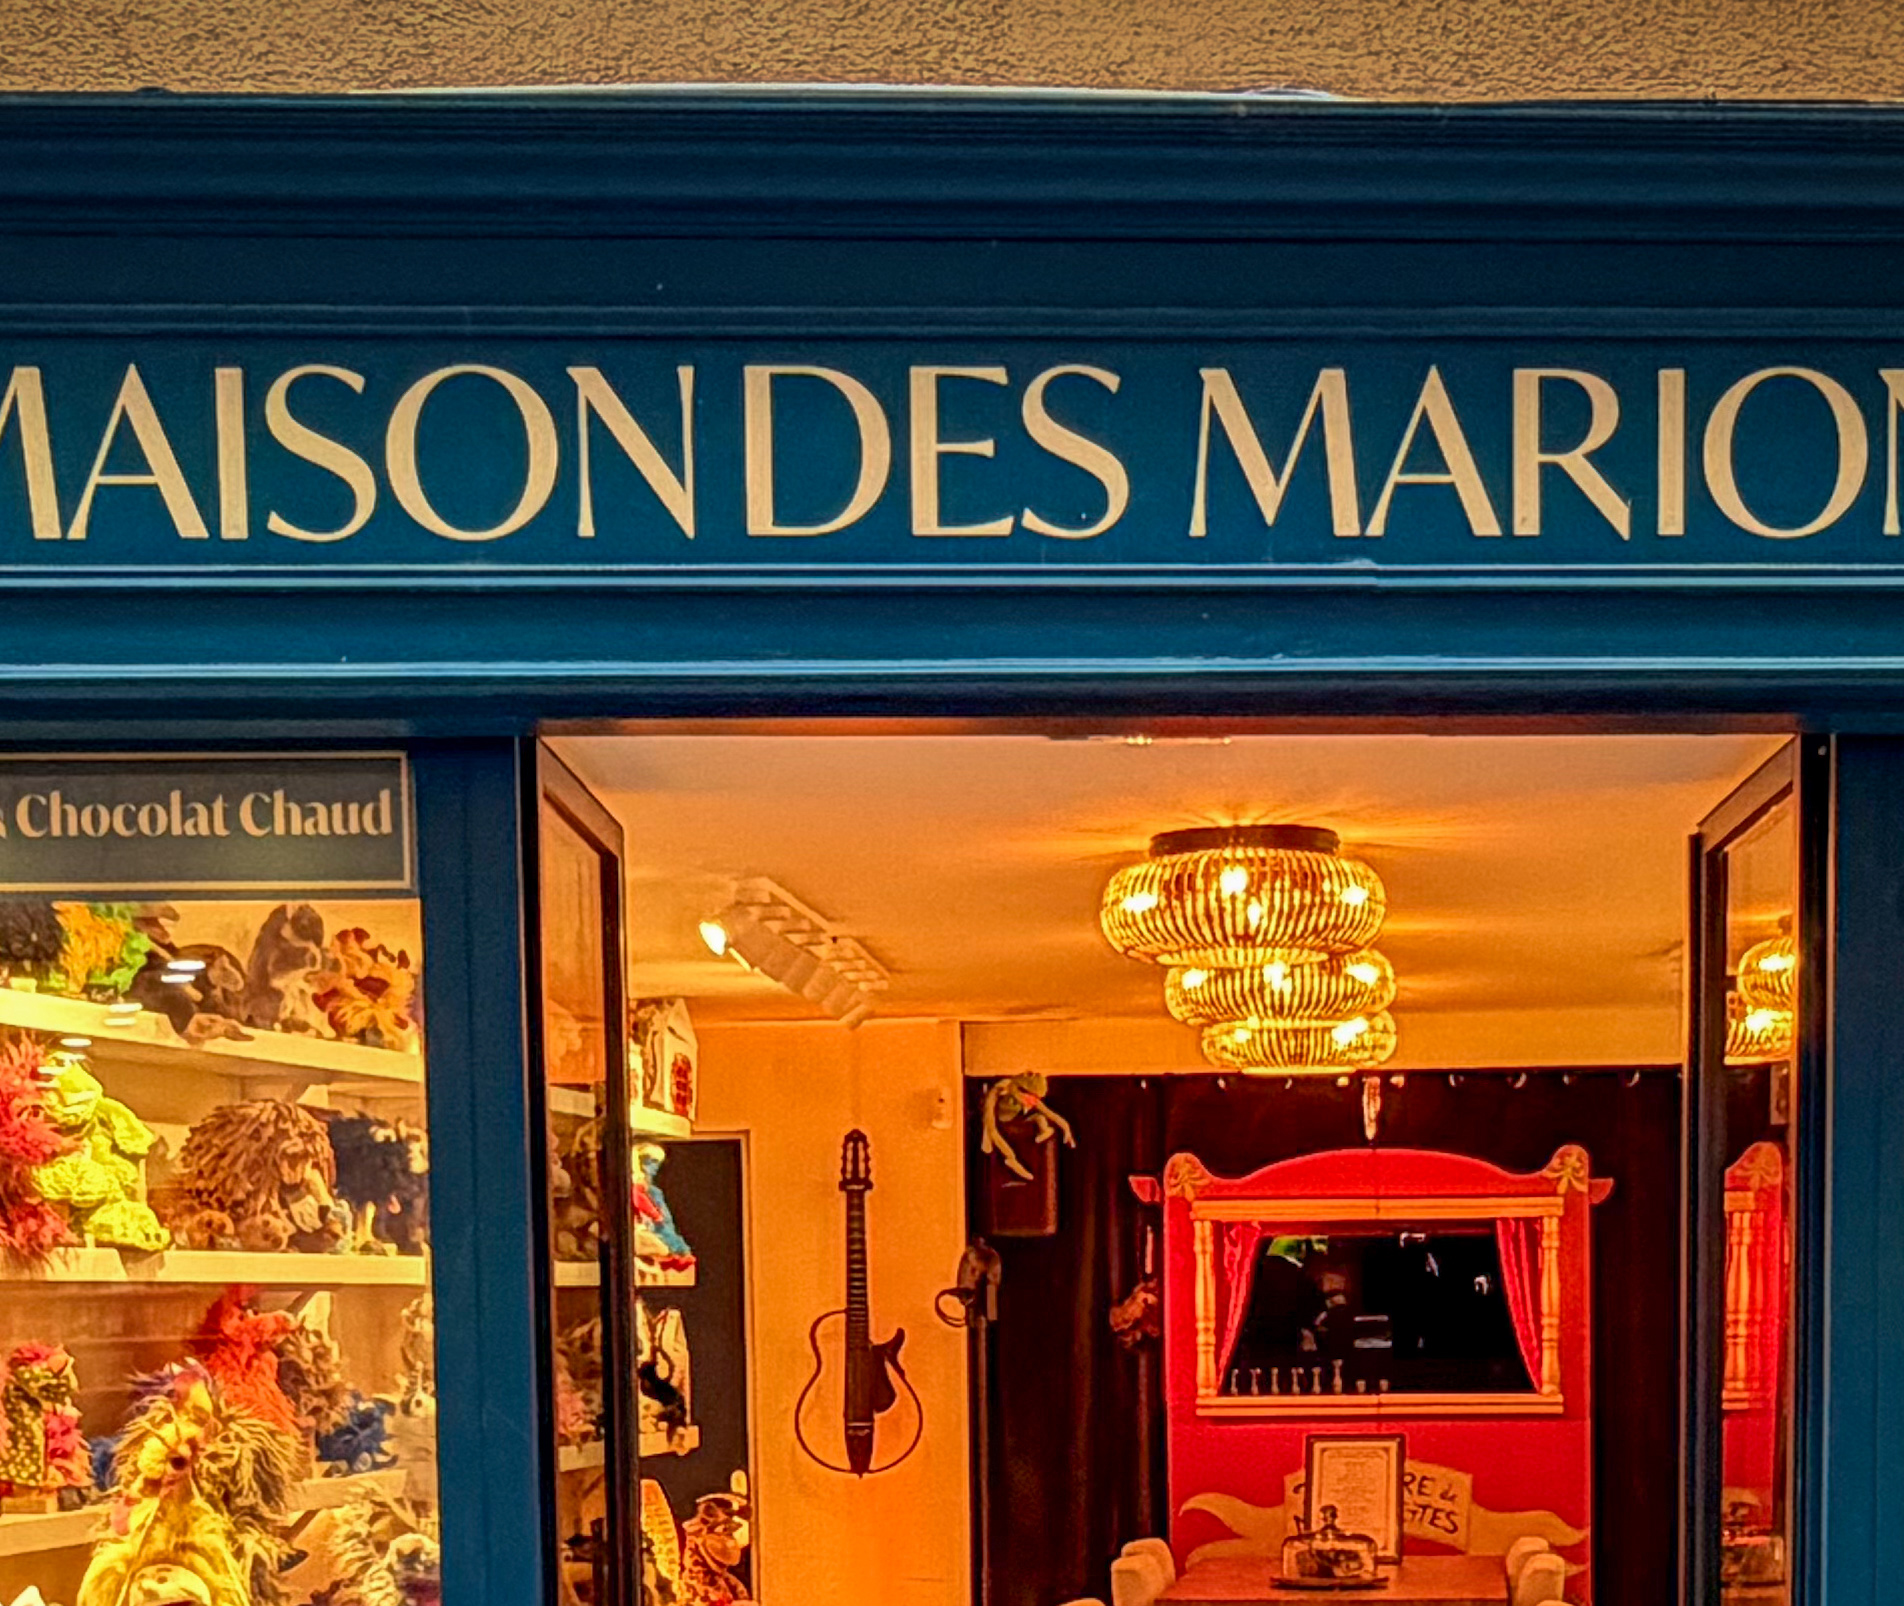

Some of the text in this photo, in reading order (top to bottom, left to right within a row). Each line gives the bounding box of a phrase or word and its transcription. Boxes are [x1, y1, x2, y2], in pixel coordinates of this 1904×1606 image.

[744, 364, 1129, 539] DES
[15, 790, 230, 838] Chocolat
[239, 788, 393, 837] Chaud
